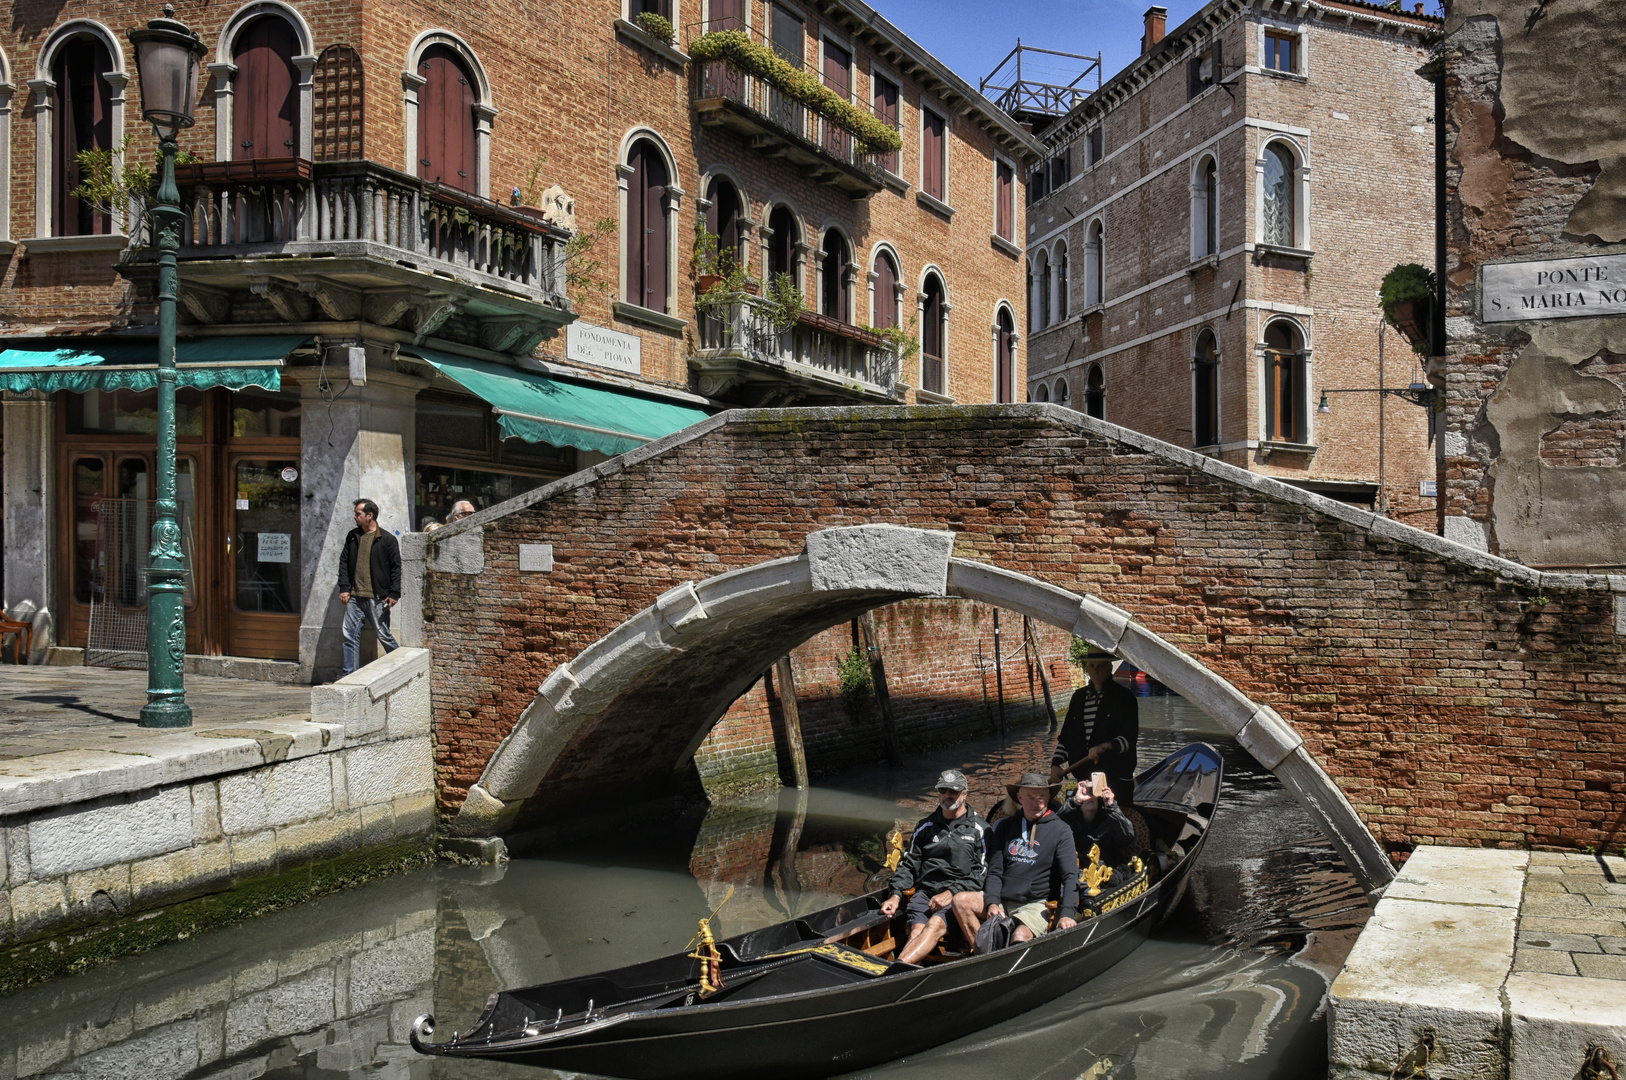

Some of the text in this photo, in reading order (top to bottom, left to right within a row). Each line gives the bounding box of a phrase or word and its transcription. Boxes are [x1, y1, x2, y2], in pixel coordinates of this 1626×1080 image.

[1537, 266, 1608, 285] PONTE
[1491, 298, 1511, 312] S.
[1521, 291, 1586, 310] MARIA
[579, 330, 631, 350] FONDAMENTA
[577, 344, 633, 365] DEL PIOVAN
